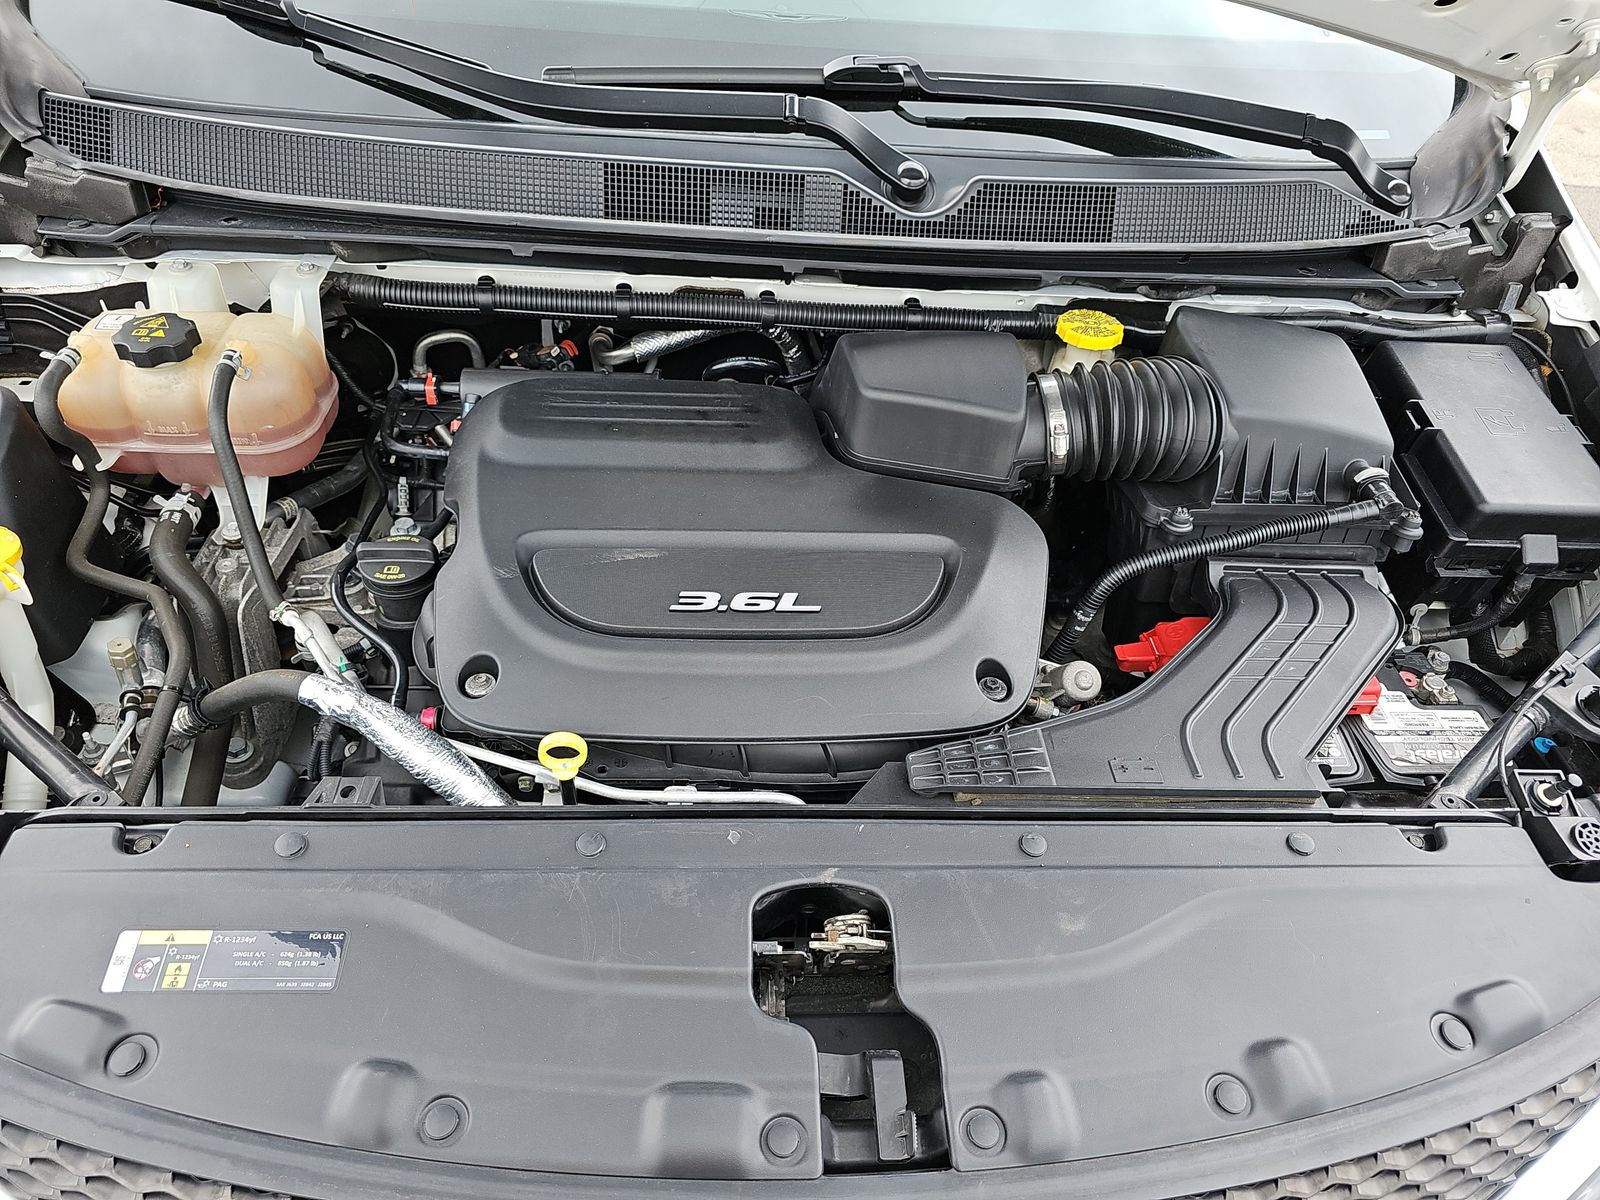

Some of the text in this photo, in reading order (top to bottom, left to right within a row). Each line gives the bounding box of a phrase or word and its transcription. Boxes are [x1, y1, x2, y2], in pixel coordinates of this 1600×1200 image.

[668, 591, 822, 613] 3.6L
[224, 936, 256, 945] R-1234yf
[277, 960, 292, 968] 850g
